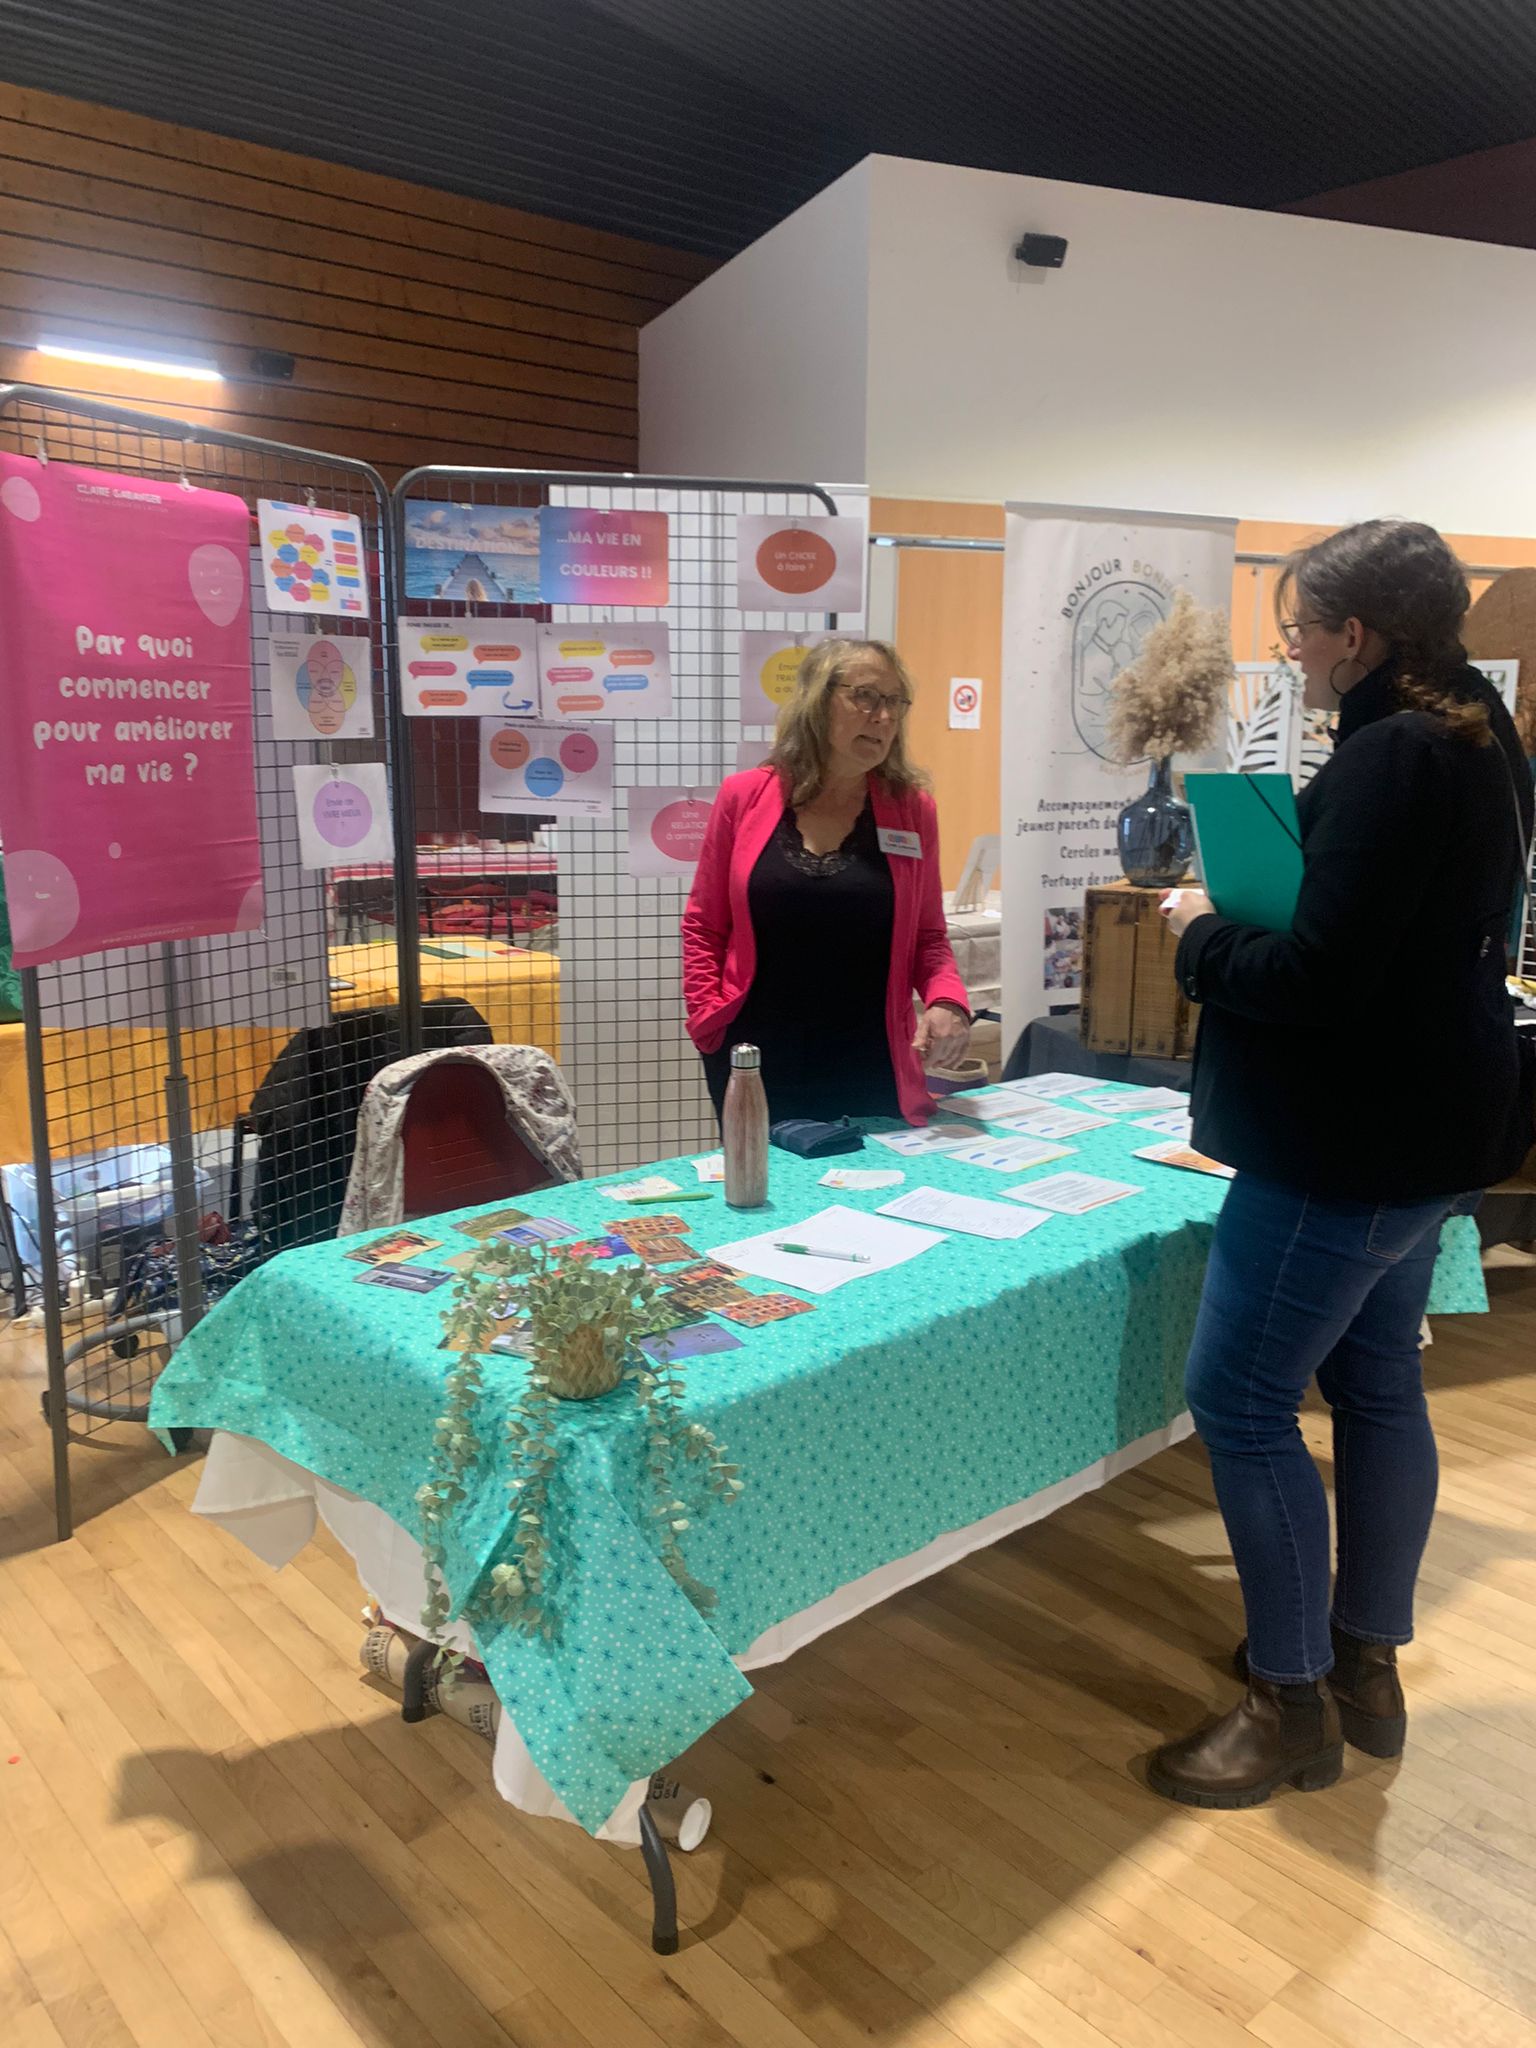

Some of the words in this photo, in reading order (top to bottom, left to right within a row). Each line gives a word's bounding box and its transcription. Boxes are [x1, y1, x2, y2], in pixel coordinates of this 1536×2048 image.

[597, 532, 620, 545] VIE
[622, 533, 641, 546] EN
[559, 563, 638, 578] COULEURS
[1061, 558, 1122, 619] BONJOUR
[76, 625, 125, 655] Par
[138, 634, 193, 659] quoi
[59, 676, 211, 700] commencer
[33, 720, 102, 750] pour
[115, 715, 233, 742] améliorer
[85, 763, 125, 785] ma
[137, 760, 173, 783] vie
[183, 752, 199, 781] ?
[1016, 819, 1055, 836] jeunes
[1057, 818, 1100, 834] parents
[1060, 845, 1099, 859] Cercles
[1041, 874, 1083, 889] Portage
[1087, 872, 1100, 885] de
